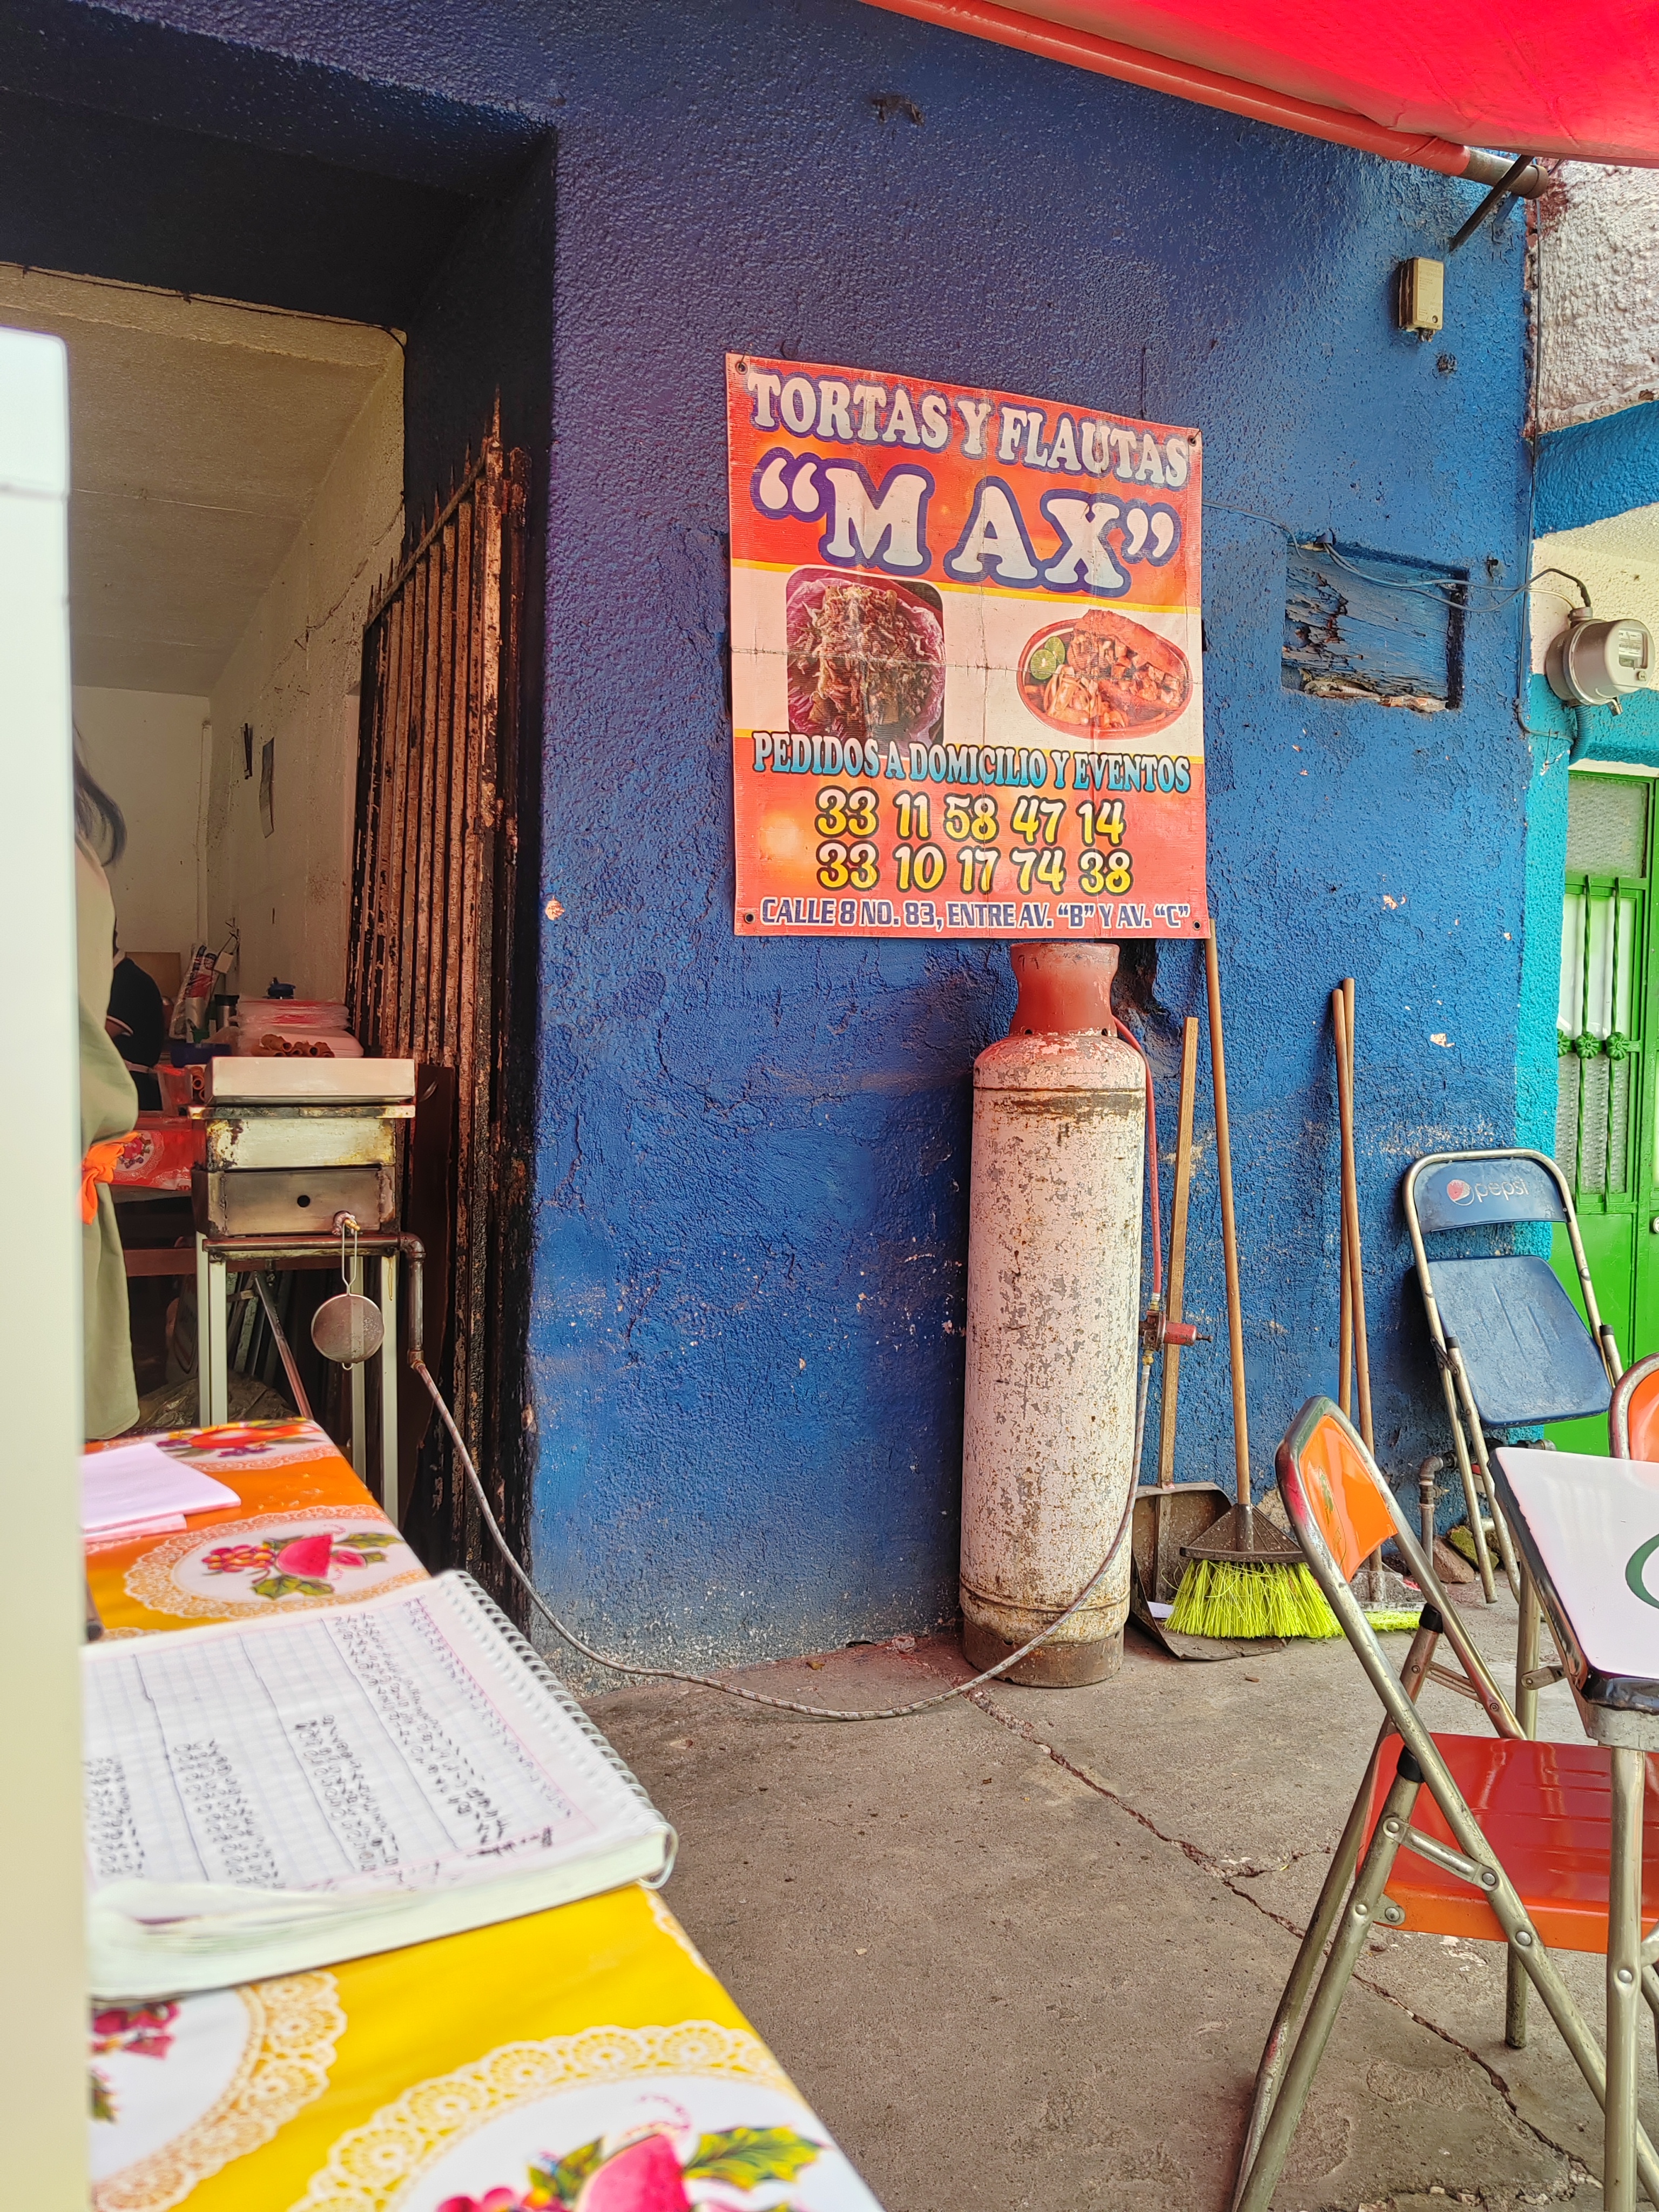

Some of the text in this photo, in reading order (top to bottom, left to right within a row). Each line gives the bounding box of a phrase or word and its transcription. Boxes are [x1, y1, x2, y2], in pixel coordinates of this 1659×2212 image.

[746, 371, 1189, 488] TORTAS Y FLAUTAS
[753, 731, 1191, 792] PEDIDOS A DOMICILIO Y EVENTOS
[815, 786, 1126, 846] 33 11 58 47 14
[816, 840, 1134, 895] 33 10 17 74 38
[761, 896, 837, 926] CALLE
[839, 899, 857, 927] 8
[859, 899, 901, 928] NO.
[904, 900, 943, 933] 83,
[947, 901, 1017, 929] ENTRE
[1017, 902, 1054, 929] AV.
[1098, 903, 1116, 929] Y
[1115, 903, 1151, 929] AV.
[1474, 1178, 1529, 1203] pepsi
